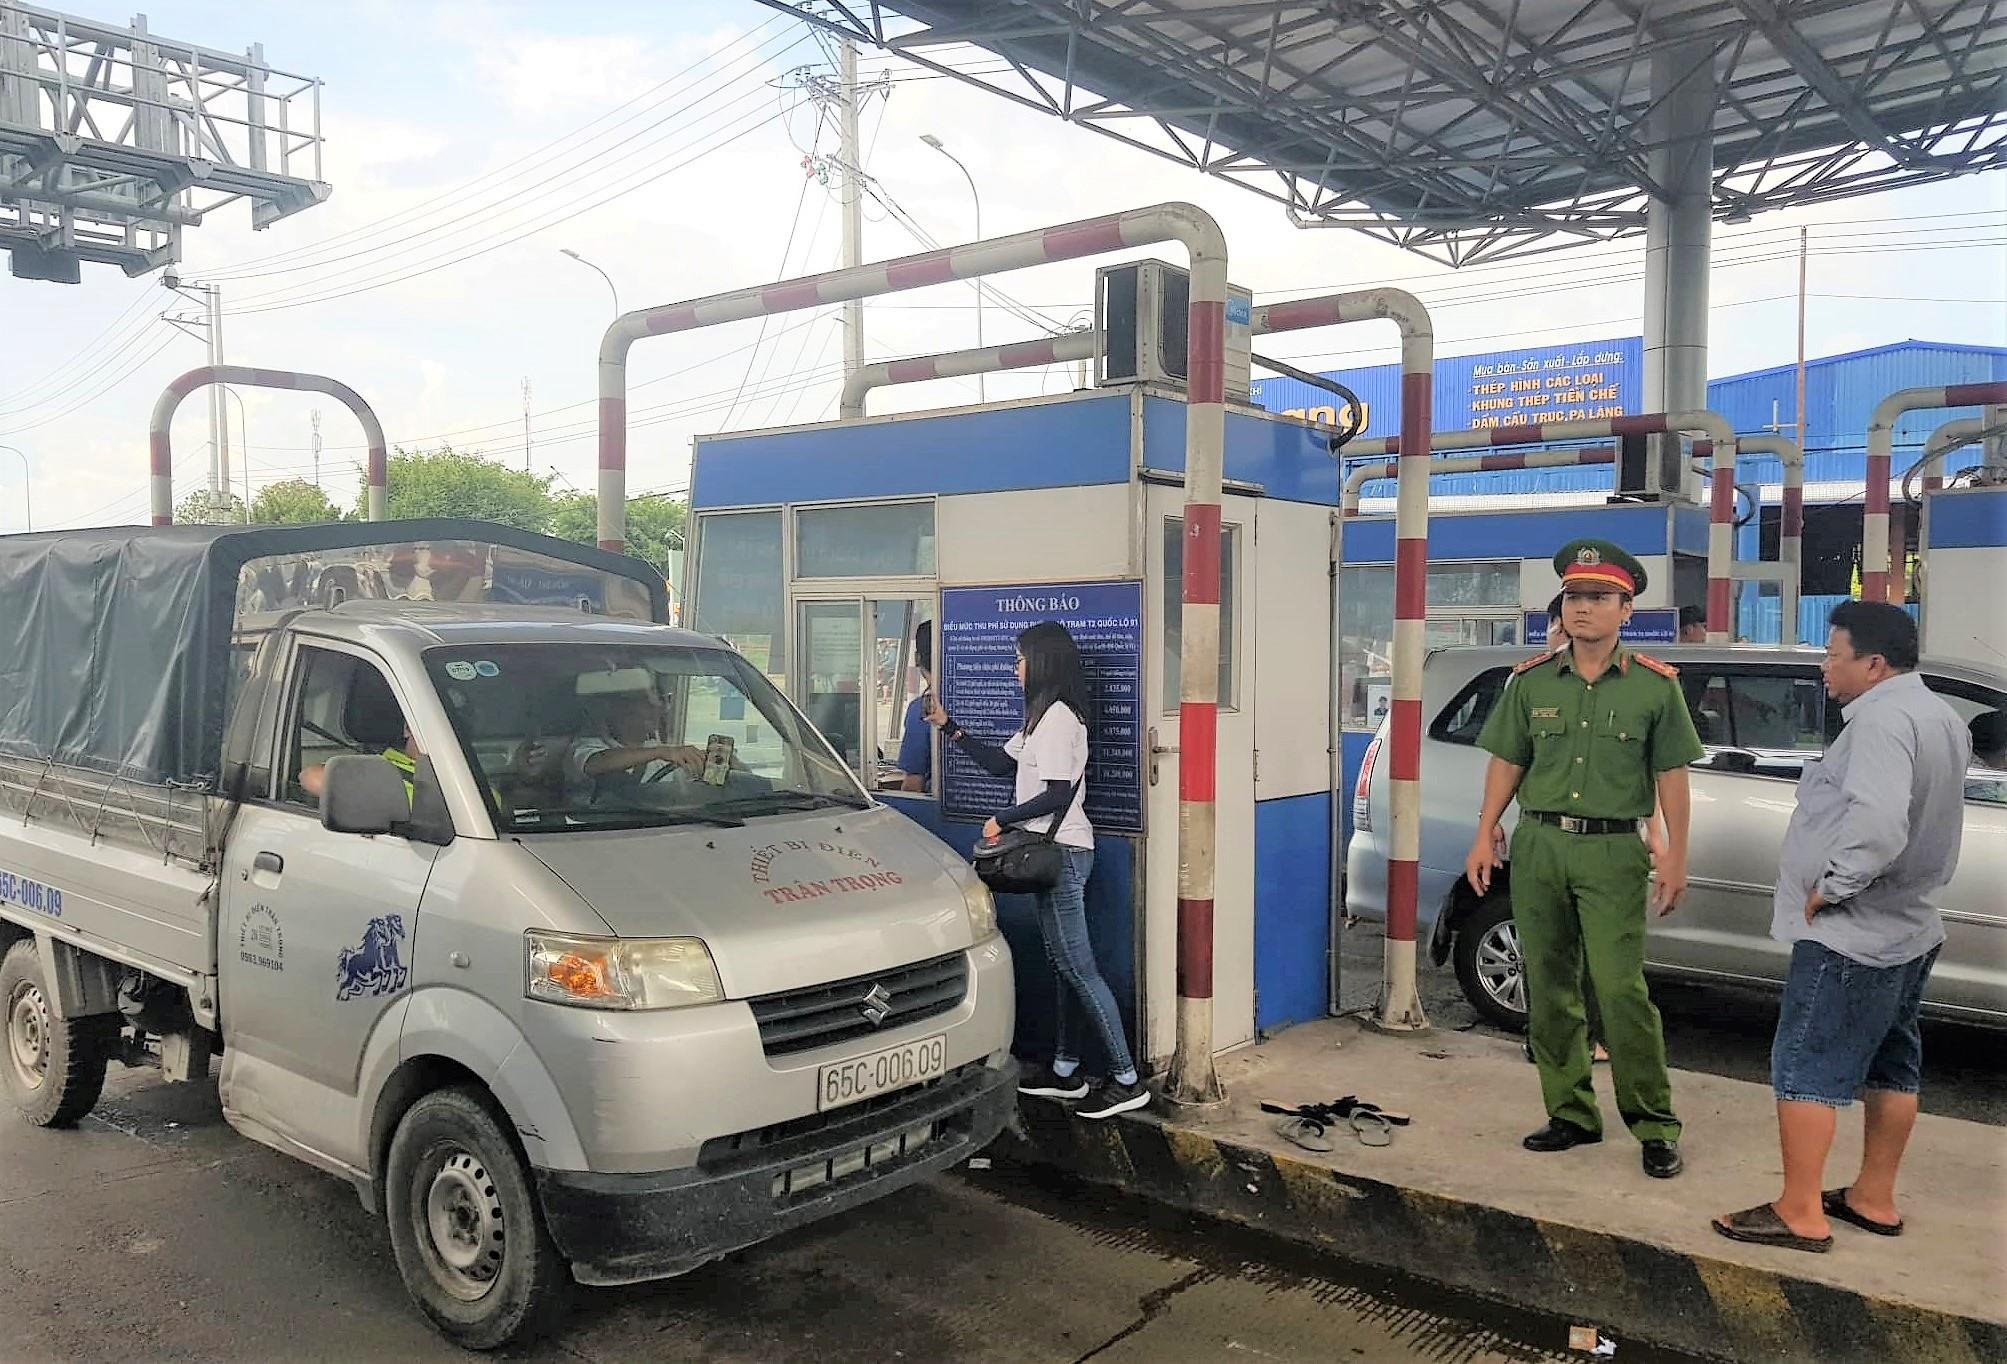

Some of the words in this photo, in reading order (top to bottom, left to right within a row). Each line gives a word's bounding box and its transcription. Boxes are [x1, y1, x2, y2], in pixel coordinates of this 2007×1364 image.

[1473, 380, 1505, 395] THÉP
[1511, 377, 1541, 391] HÌNH
[1546, 373, 1571, 388] CÁC
[1472, 397, 1513, 411] KHUNG
[1519, 391, 1550, 407] THÉP
[996, 595, 1046, 612] THÔNG
[974, 621, 987, 630] THU
[987, 620, 999, 630] PHÍ
[0, 871, 62, 917] 5C-006.09
[826, 1041, 942, 1102] 65C-006.09
